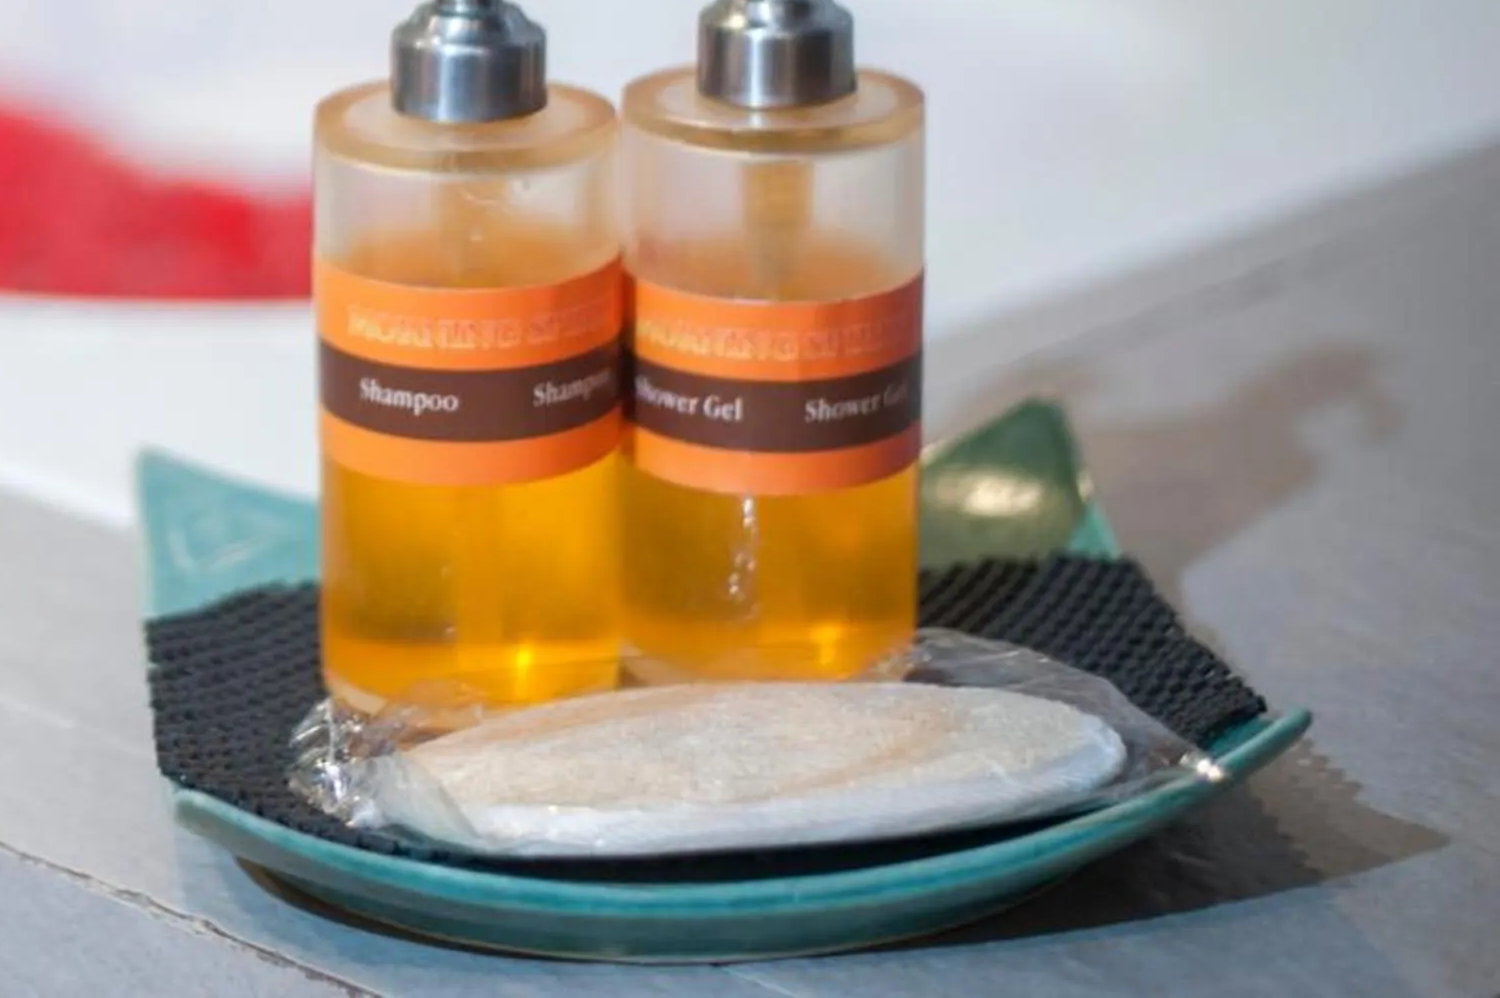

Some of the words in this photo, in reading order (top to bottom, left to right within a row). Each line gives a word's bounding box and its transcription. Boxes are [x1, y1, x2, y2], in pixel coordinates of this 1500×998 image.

[358, 377, 460, 416] Shampoo
[702, 393, 744, 422] Gel
[804, 396, 881, 423] Shower
